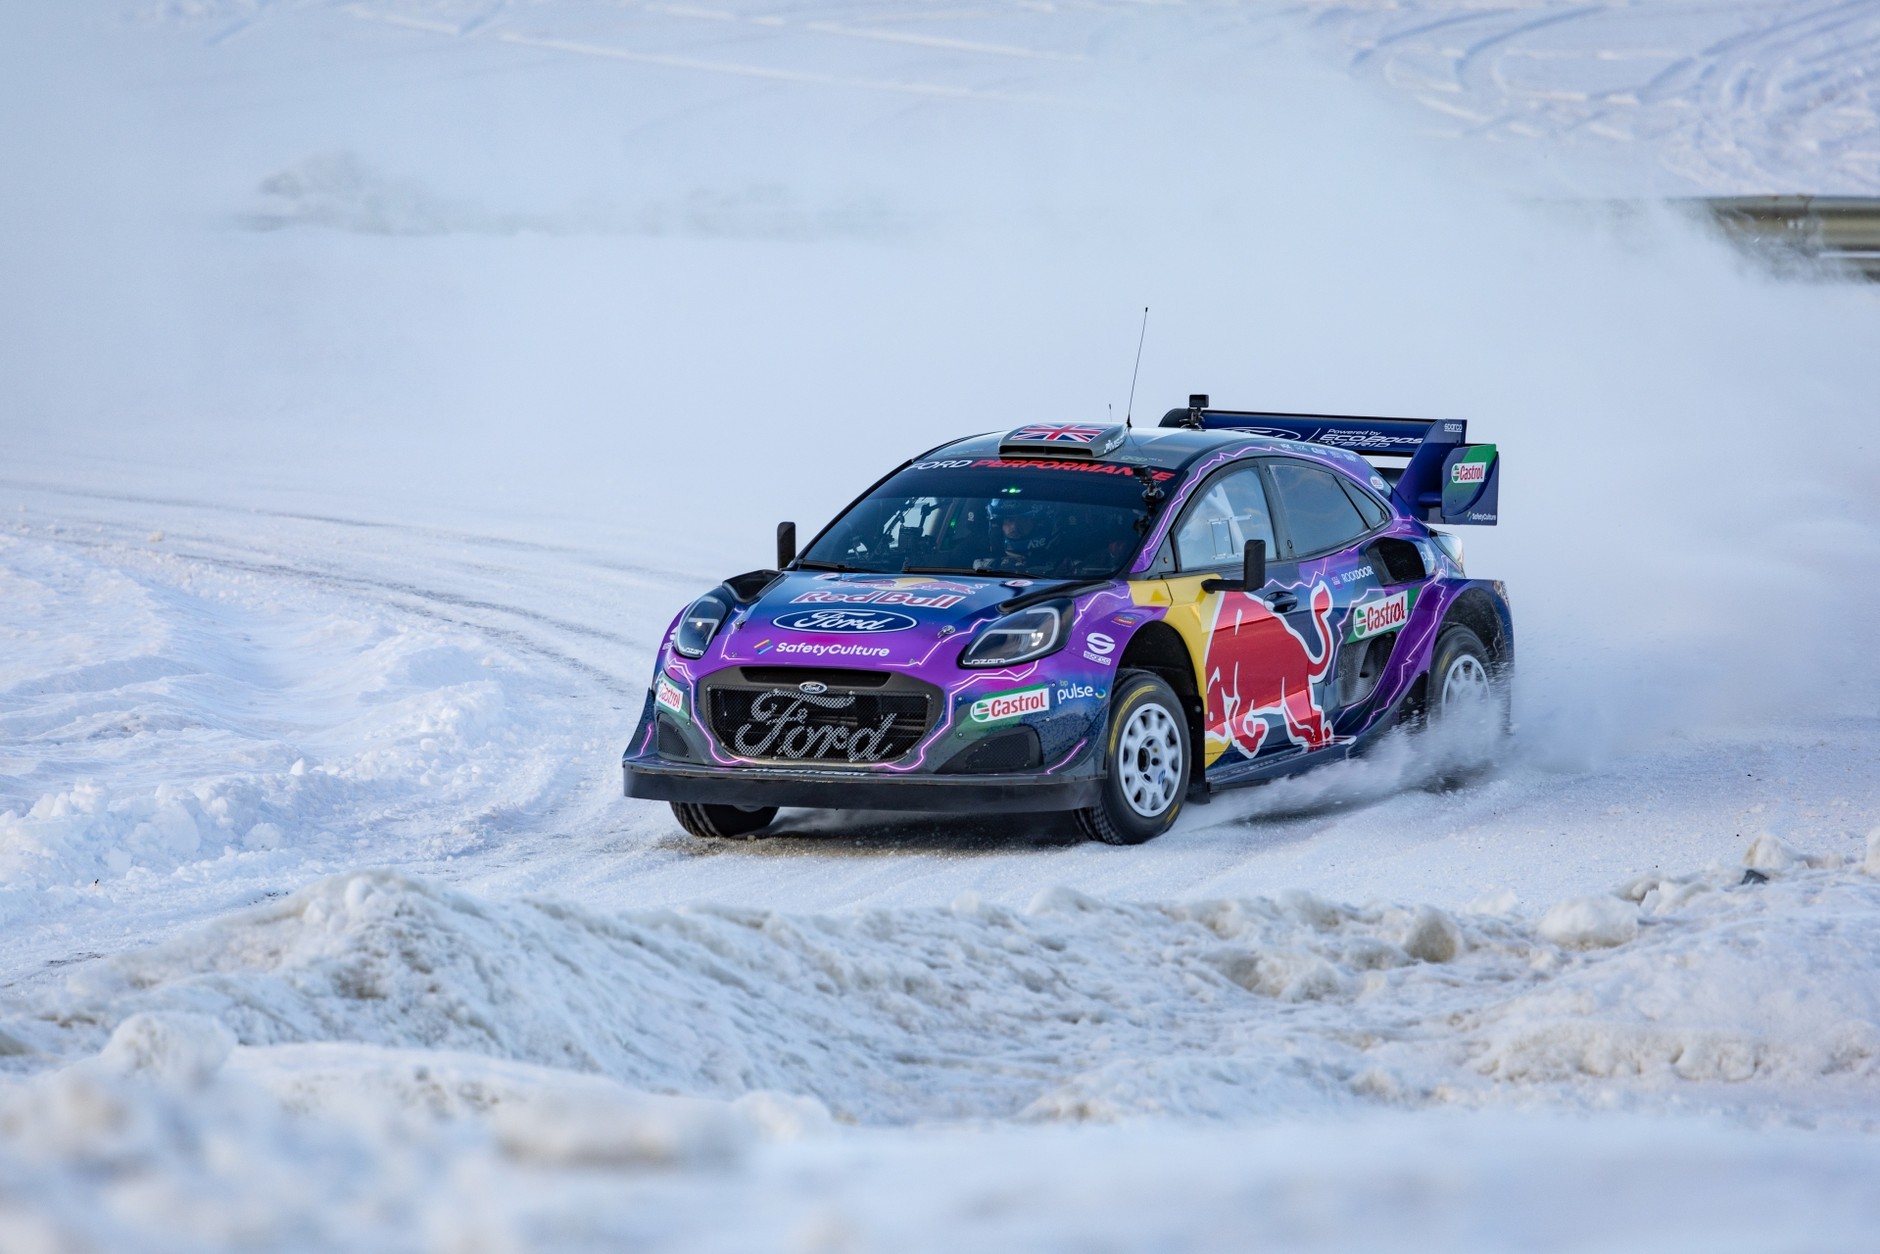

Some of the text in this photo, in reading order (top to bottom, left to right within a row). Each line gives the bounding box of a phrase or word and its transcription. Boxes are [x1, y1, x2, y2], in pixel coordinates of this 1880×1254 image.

[1327, 428, 1369, 436] Powered
[1318, 440, 1391, 448] YBRID
[904, 458, 1176, 481] FORD PERFORMANE
[1460, 465, 1484, 481] Castrol
[1472, 512, 1497, 521] SafetyCulture
[1341, 565, 1374, 583] ROCKDOOR
[789, 591, 968, 609] Red Bull
[794, 610, 893, 631] Ford
[1367, 596, 1405, 632] Castrol
[776, 642, 890, 657] SafetyCulture
[1059, 679, 1069, 688] bp
[1056, 683, 1094, 705] pulse
[990, 692, 1046, 717] Castrol
[734, 688, 897, 761] Ford
